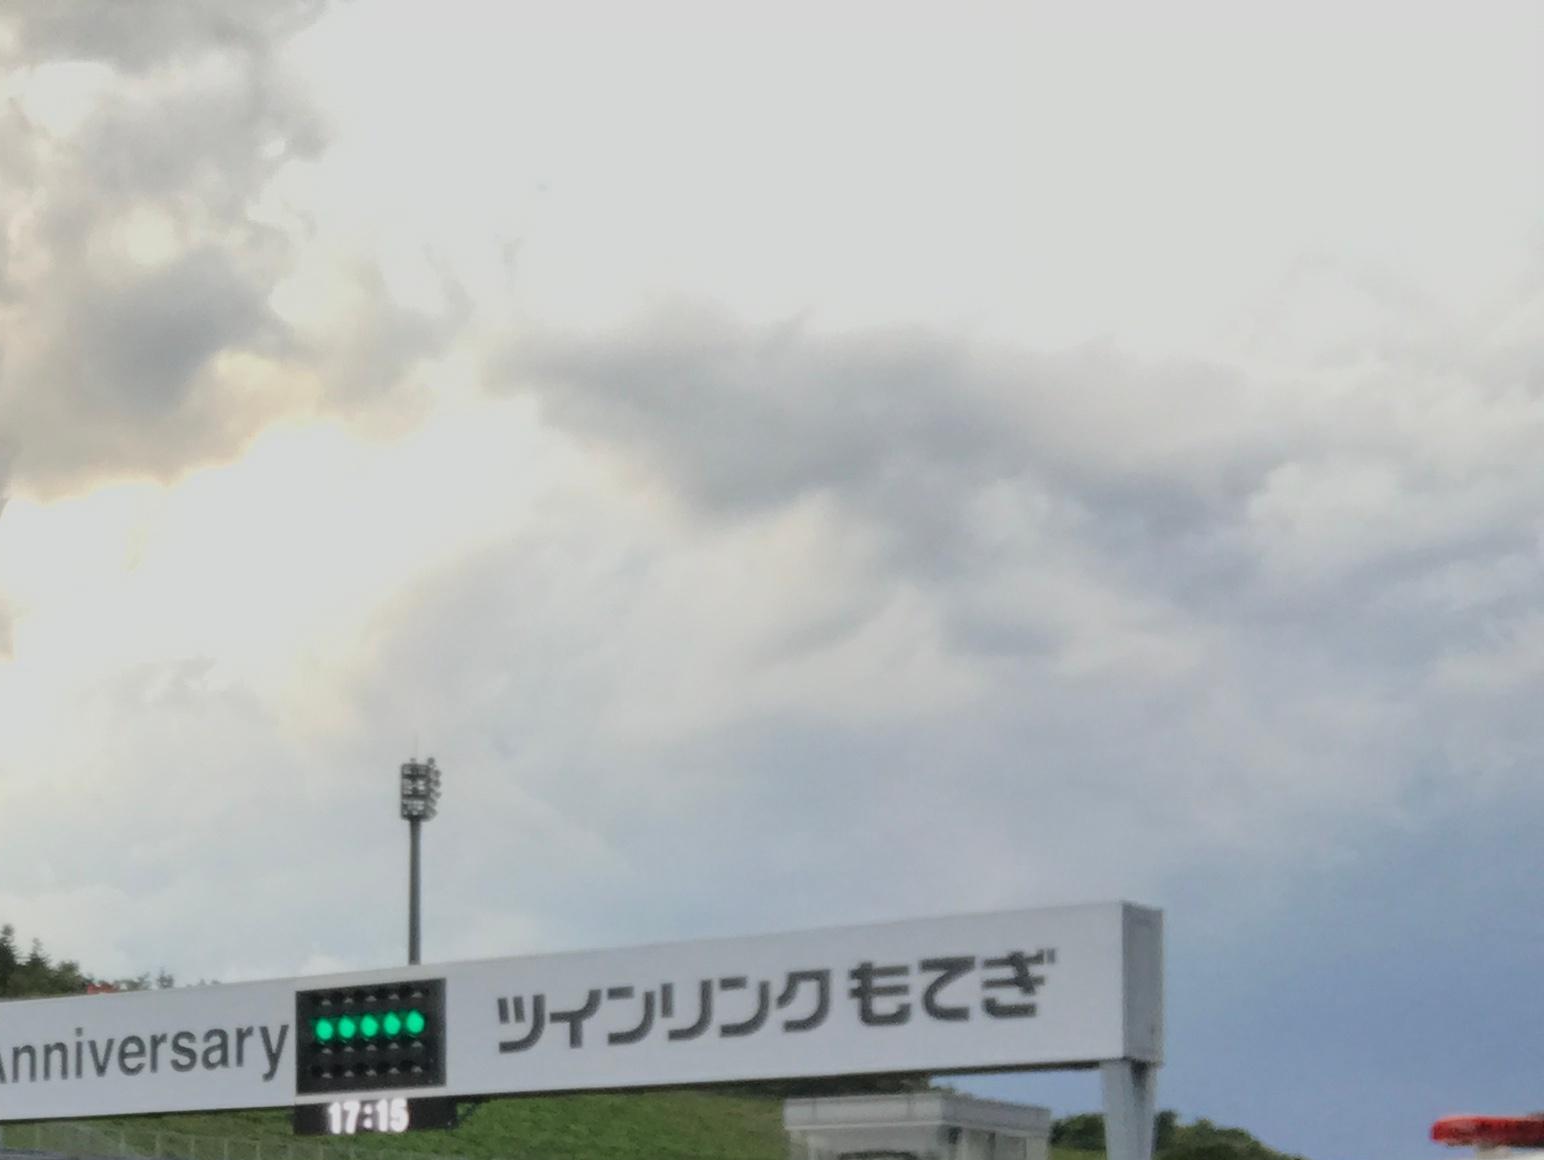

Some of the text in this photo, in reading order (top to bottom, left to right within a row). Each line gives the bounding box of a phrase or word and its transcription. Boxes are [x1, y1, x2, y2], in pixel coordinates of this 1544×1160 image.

[497, 949, 1056, 1054] ツインリングもてぎ
[329, 1097, 410, 1135] 17:15
